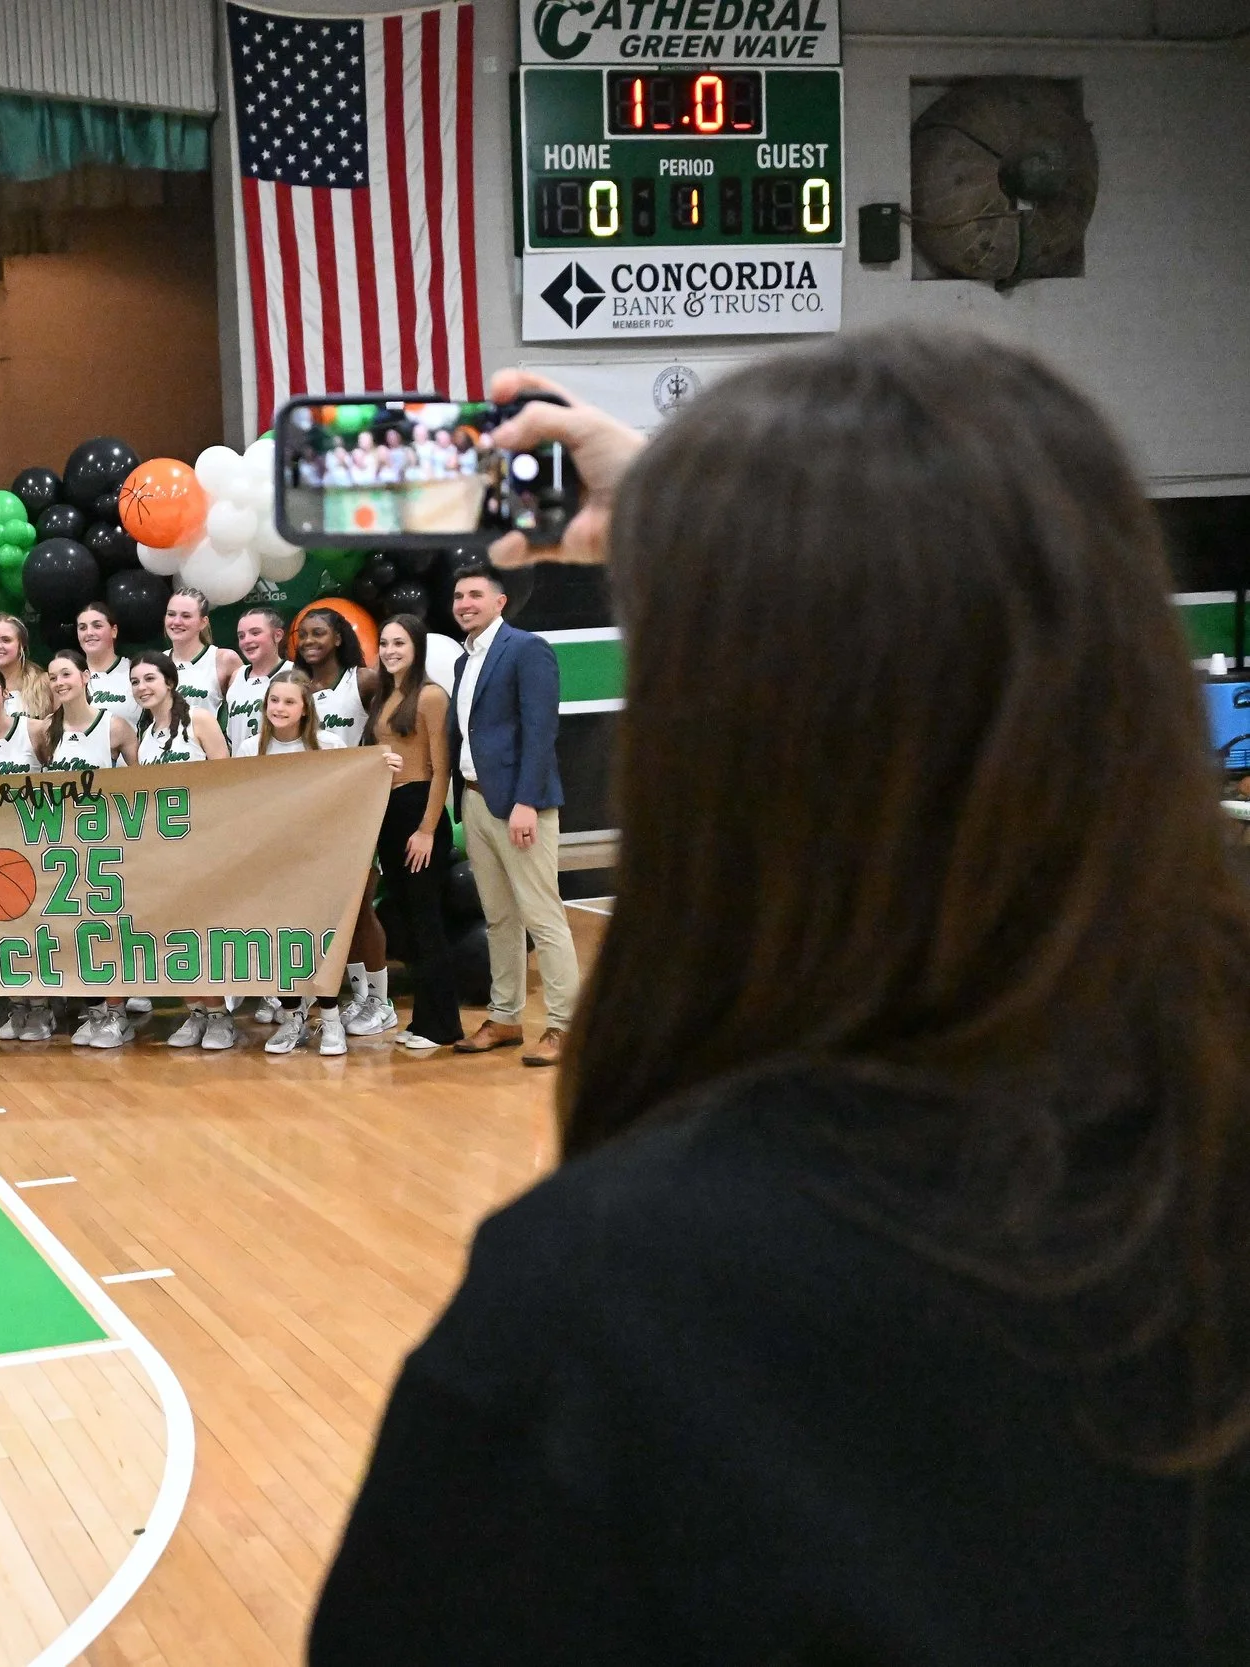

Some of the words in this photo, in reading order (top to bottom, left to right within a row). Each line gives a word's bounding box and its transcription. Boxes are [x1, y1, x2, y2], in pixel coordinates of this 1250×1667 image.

[533, 0, 828, 60] CATHEDRAL
[619, 34, 725, 58] GREEN
[732, 34, 820, 58] WAVE
[543, 143, 612, 171] HOME
[659, 158, 714, 177] PERIOD
[756, 143, 829, 170] GUEST
[589, 180, 619, 237] 0
[690, 188, 699, 226] 1
[802, 178, 831, 234] 0
[611, 260, 818, 293] CONCORDIA
[612, 295, 677, 317] BANK
[682, 290, 707, 318] &
[710, 293, 784, 314] TRUST
[791, 292, 824, 313] CO.
[612, 319, 651, 330] MEMBER
[653, 318, 674, 329] FDIC
[41, 845, 125, 917] 25
